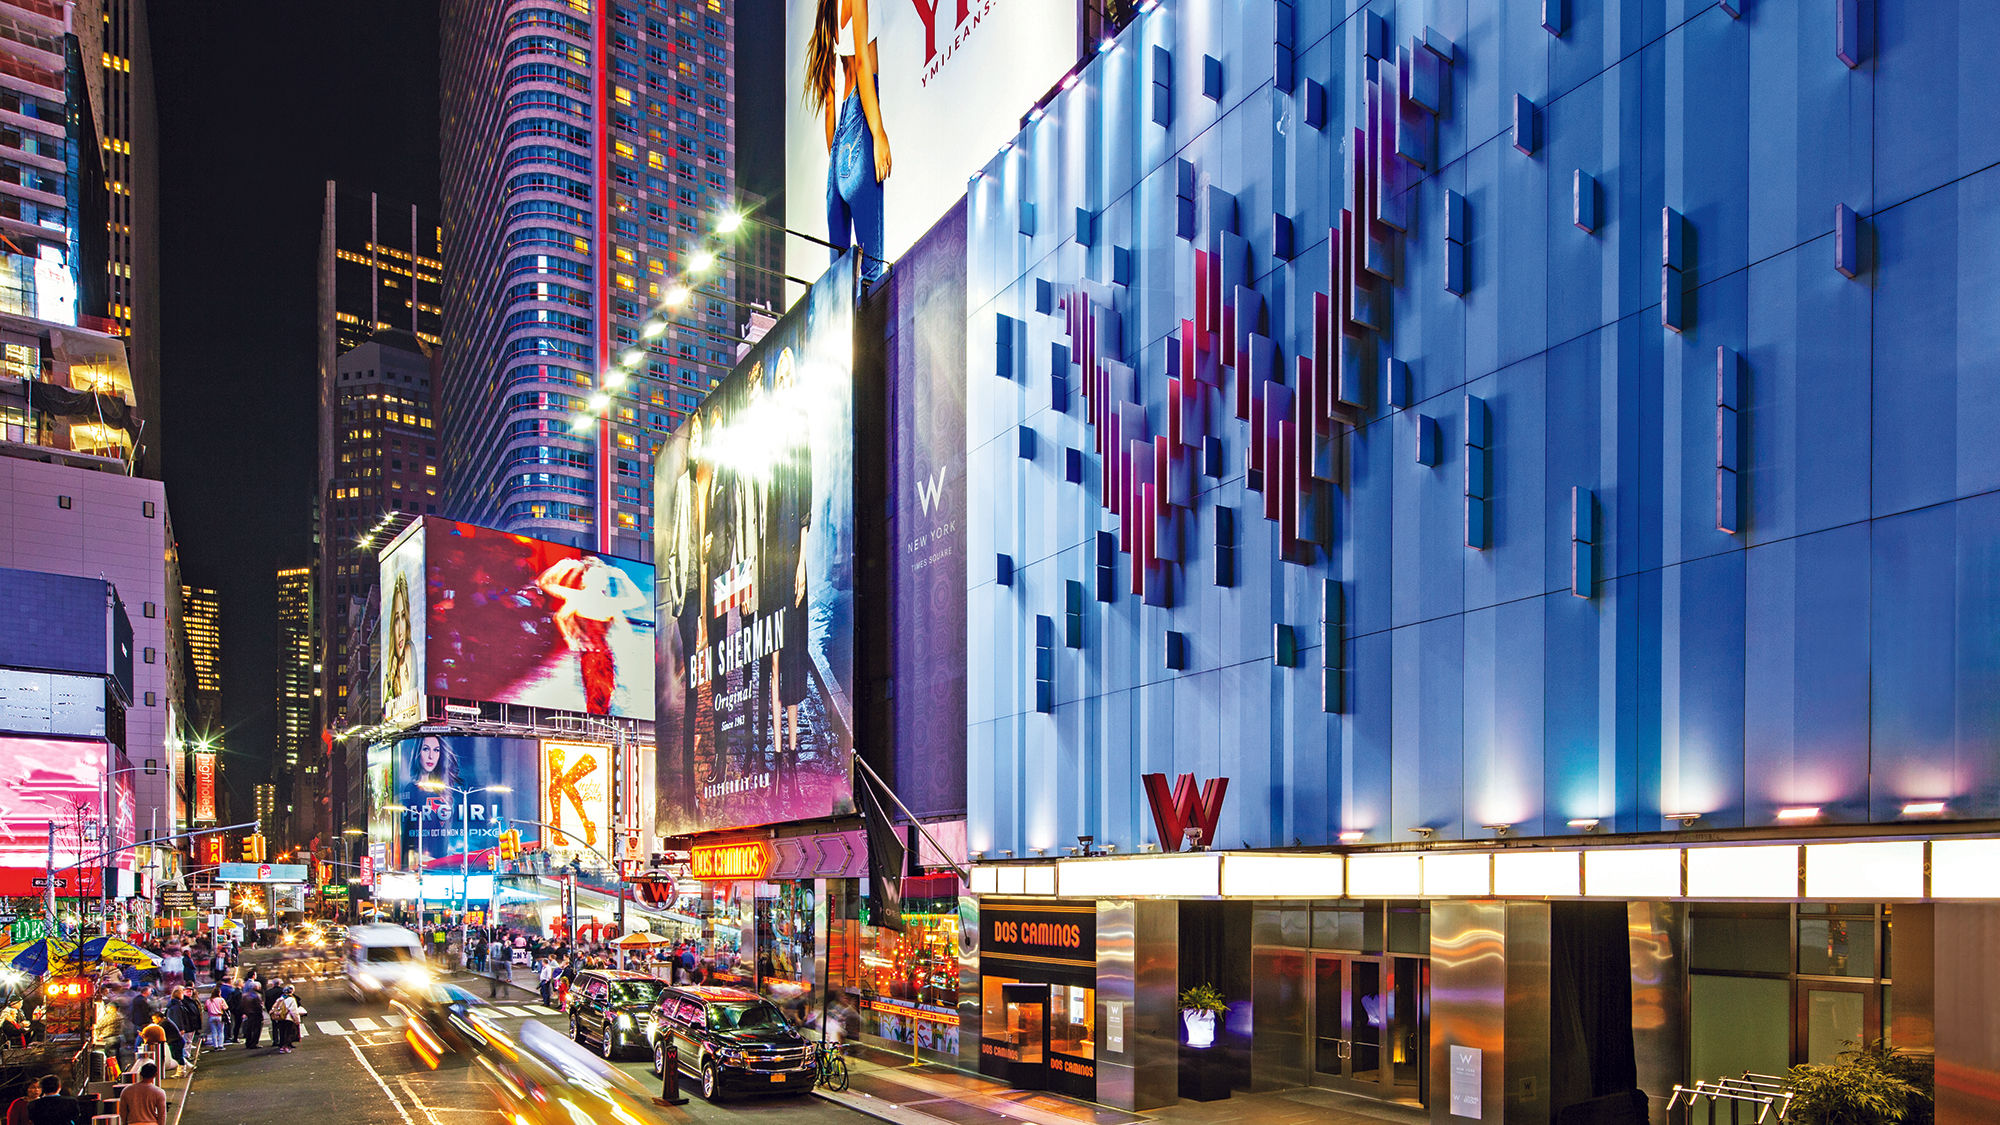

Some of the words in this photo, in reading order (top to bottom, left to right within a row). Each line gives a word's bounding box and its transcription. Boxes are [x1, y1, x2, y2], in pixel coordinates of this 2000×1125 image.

[916, 465, 947, 517] W
[907, 534, 928, 554] NEW
[930, 520, 956, 542] YORK
[911, 558, 928, 572] TIMES
[929, 546, 953, 566] SQUARE
[690, 645, 713, 690] BEN
[718, 607, 785, 676] SHERMAN
[714, 680, 753, 712] Original
[721, 720, 734, 732] Since
[735, 715, 746, 728] 1963
[1141, 771, 1230, 853] W
[431, 828, 440, 837] OCT
[446, 828, 459, 837] MON
[694, 849, 713, 877] DOS
[714, 846, 760, 876] CAMINOS
[647, 882, 672, 903] W
[994, 920, 1018, 944] DOS
[1021, 922, 1081, 949] CAMINOS
[982, 1043, 993, 1055] DOS
[993, 1044, 1019, 1062] CAMINOS
[1459, 1053, 1472, 1065] W
[1050, 1057, 1064, 1072] DOS
[1064, 1060, 1094, 1078] CAMINOS
